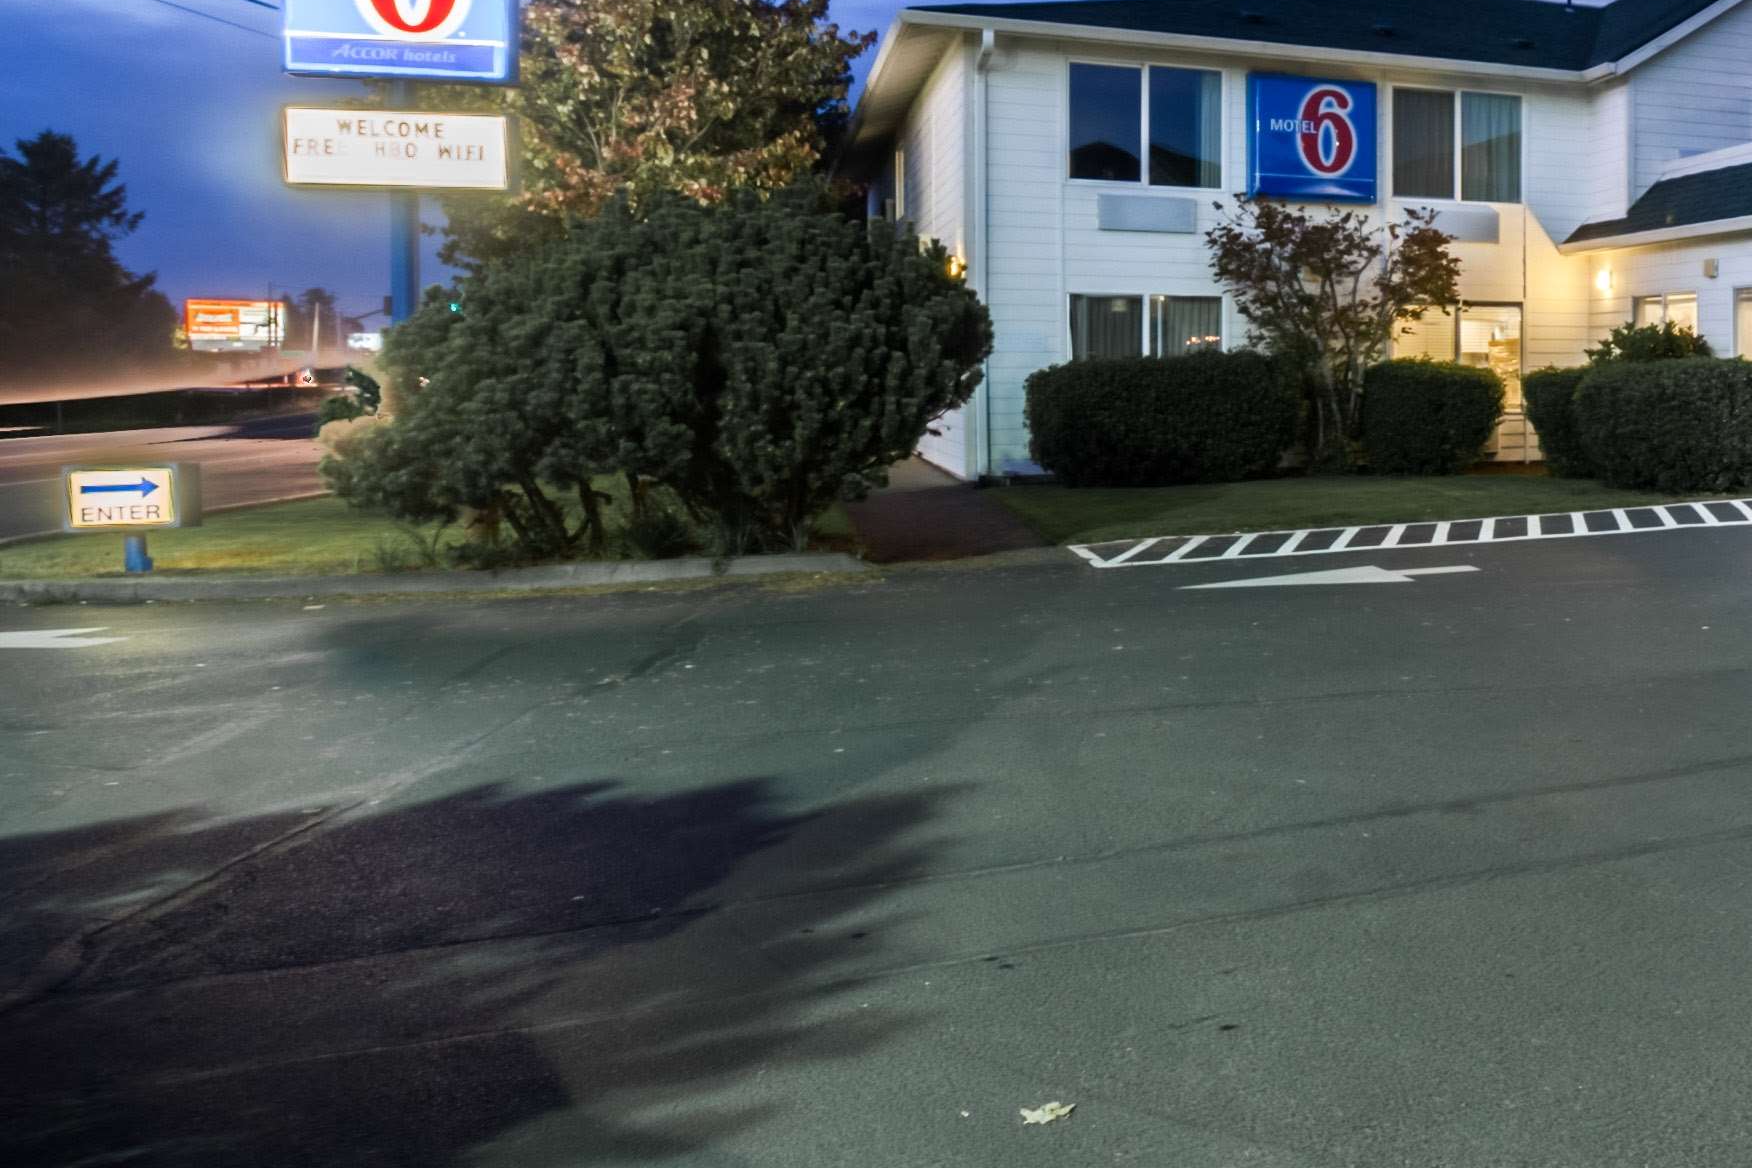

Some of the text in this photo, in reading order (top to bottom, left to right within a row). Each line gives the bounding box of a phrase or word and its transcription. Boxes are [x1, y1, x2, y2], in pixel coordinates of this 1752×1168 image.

[403, 48, 457, 64] hotels
[337, 119, 444, 139] WELCOME
[1270, 87, 1354, 175] MOTEL 6
[438, 144, 485, 161] WIFI
[80, 504, 161, 522] ENTER
